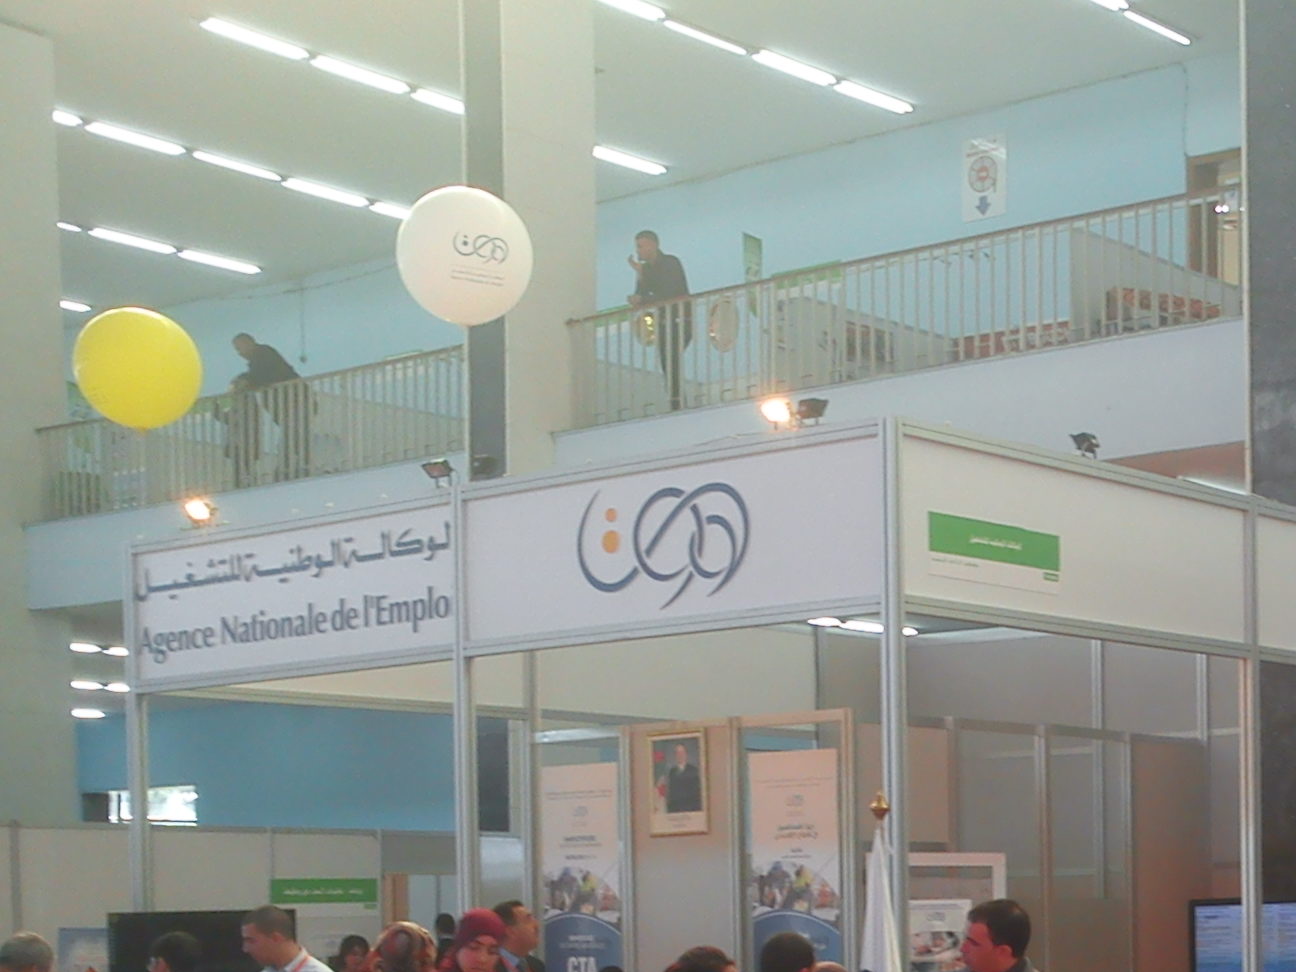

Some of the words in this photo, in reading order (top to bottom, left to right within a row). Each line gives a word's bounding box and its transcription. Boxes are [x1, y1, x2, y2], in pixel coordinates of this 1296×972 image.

[343, 520, 451, 570] لوكالة
[141, 626, 216, 664] Agence
[220, 602, 329, 645] Nationale
[331, 597, 360, 633] de
[363, 585, 451, 634] l'Emplo
